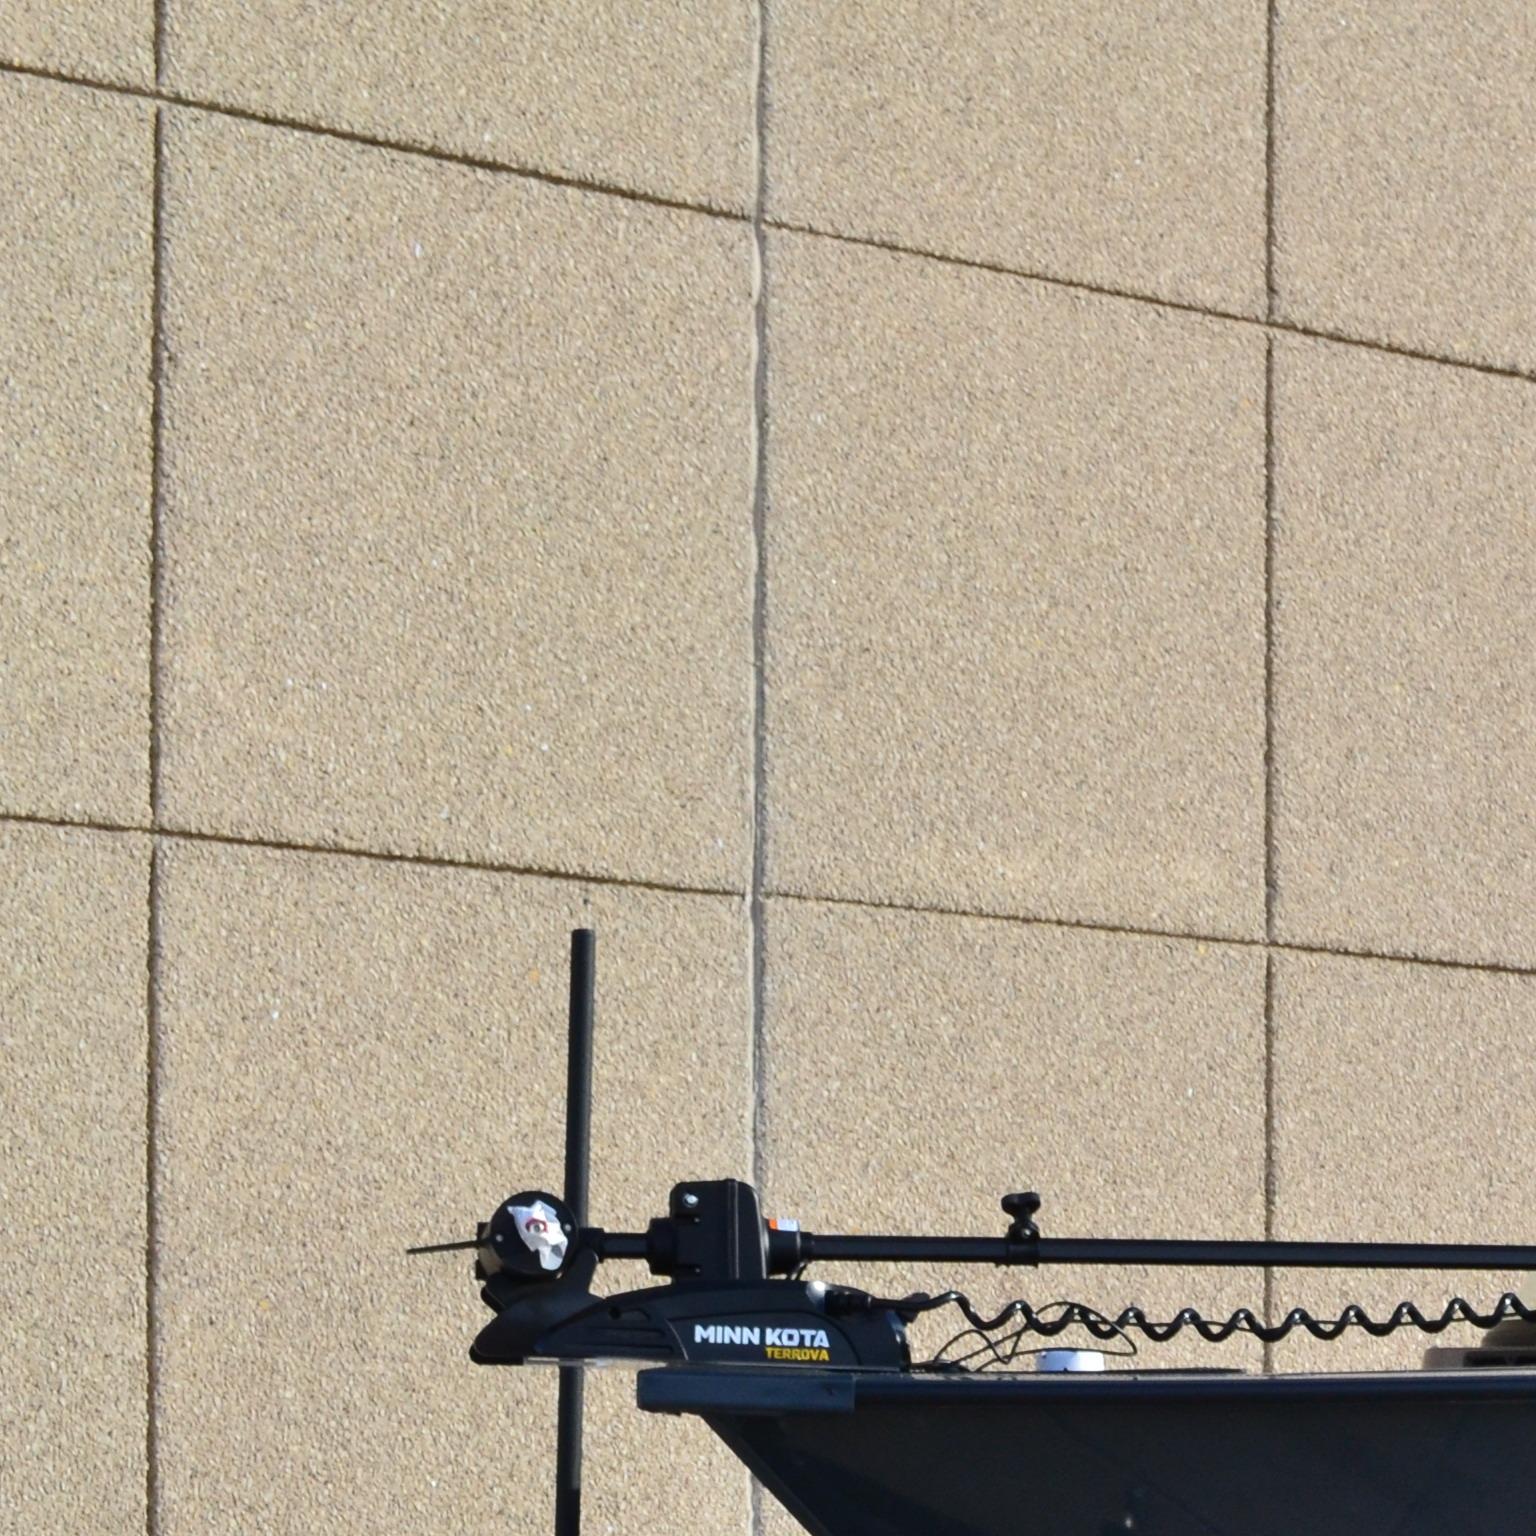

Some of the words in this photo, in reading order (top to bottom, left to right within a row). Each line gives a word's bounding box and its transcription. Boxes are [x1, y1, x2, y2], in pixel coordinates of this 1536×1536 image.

[694, 1324, 761, 1345] MINN
[765, 1327, 830, 1348] KOTA
[765, 1347, 830, 1361] TERROVA
